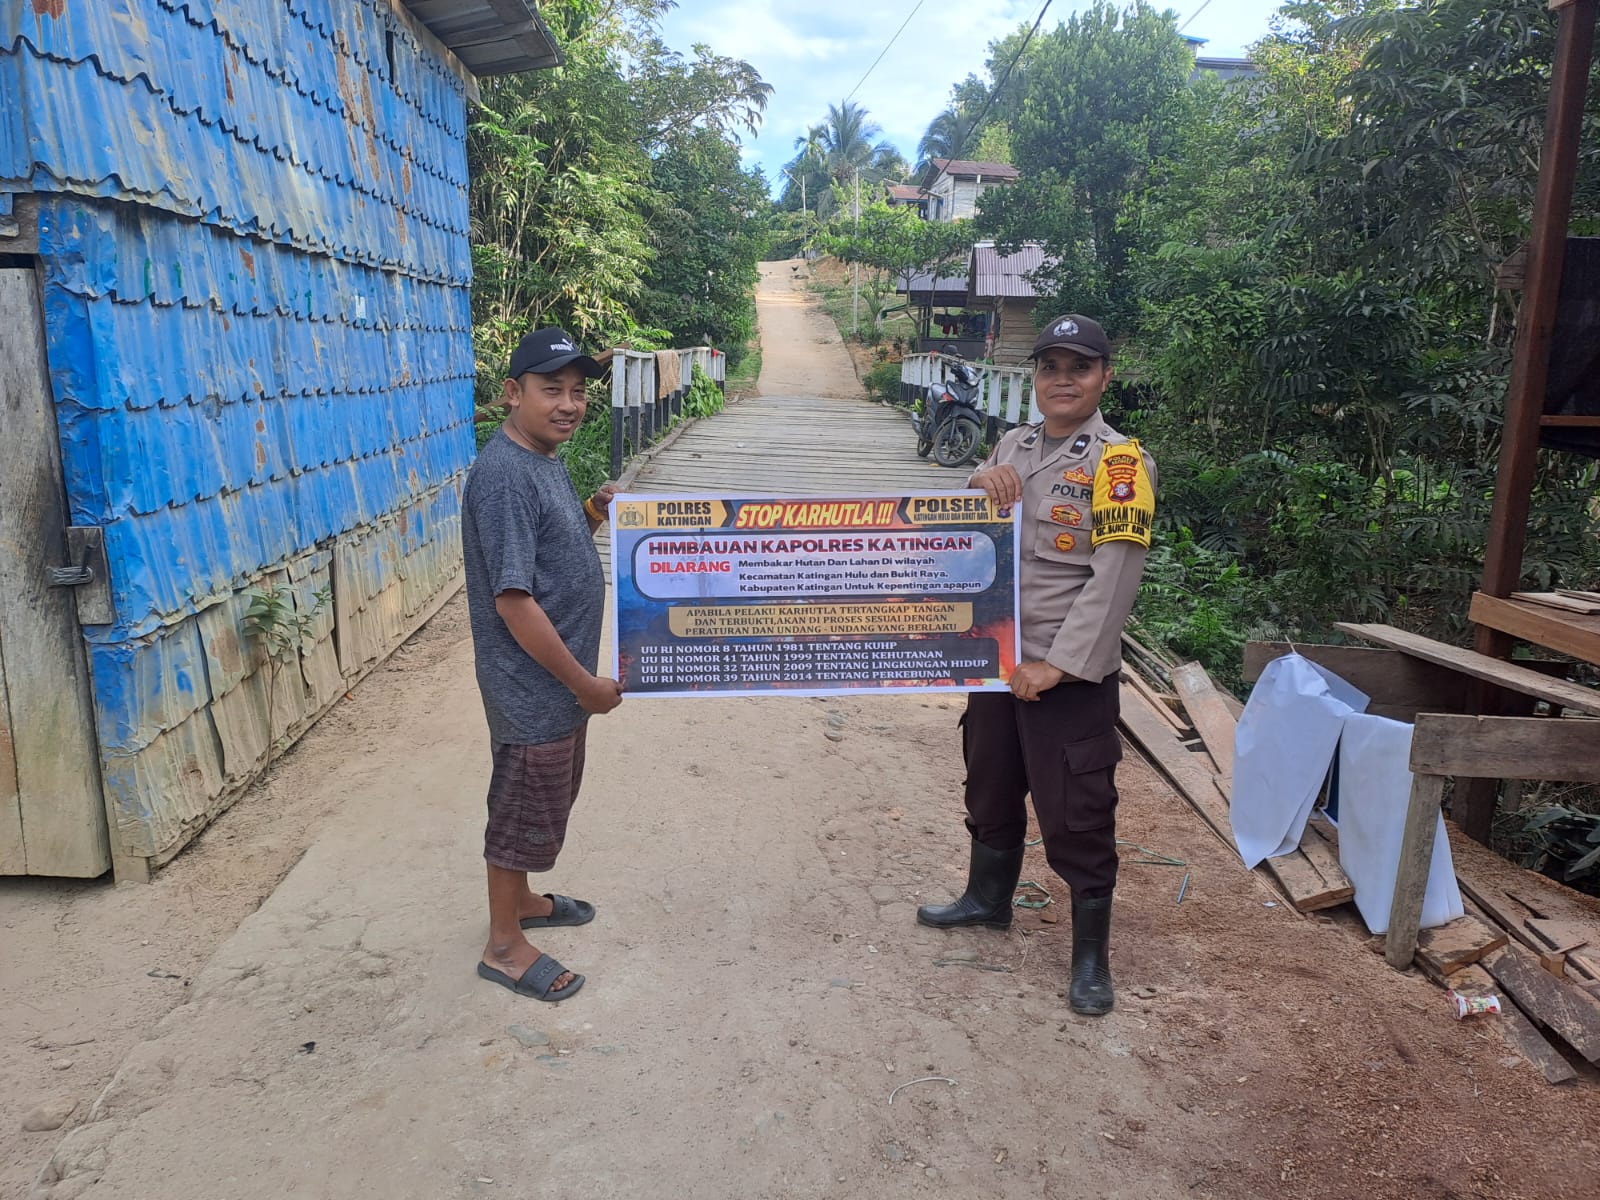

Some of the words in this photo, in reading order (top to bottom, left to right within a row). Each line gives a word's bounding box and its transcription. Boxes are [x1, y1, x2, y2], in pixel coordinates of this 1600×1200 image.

[657, 502, 711, 515] POLRES
[914, 498, 987, 512] POLSEK
[657, 516, 711, 526] KATINGAN
[735, 503, 784, 528] STOP
[782, 502, 874, 527] KARHUTLA
[875, 502, 896, 526] !!!
[648, 540, 757, 555] HIMBAUAN
[761, 539, 863, 553] KAPOLRES
[867, 537, 973, 552] KATINGAN
[650, 561, 731, 573] DILARANG
[738, 560, 792, 568] Membakar
[795, 559, 826, 567] Hutan
[827, 558, 848, 566] Dan
[849, 558, 880, 566] Lahan
[882, 557, 893, 565] Di
[894, 557, 935, 566] wilayah
[739, 573, 795, 581] Kecamatan
[797, 572, 842, 581] Katingan
[844, 571, 868, 579] Hulu
[870, 571, 889, 579] dan
[890, 570, 918, 578] Bukit
[920, 570, 949, 579] Raya.
[740, 584, 795, 593] Kabupaten
[797, 583, 842, 593] Katingan
[844, 582, 874, 591] Untuk
[877, 581, 942, 591] Kepentingan
[943, 582, 982, 590] apapun
[686, 609, 732, 617] APABILA
[734, 608, 776, 616] PELAKU
[778, 607, 837, 616] KARHUTLA
[839, 605, 909, 614] TERTANGKAP
[911, 605, 955, 613] TANGAN
[694, 618, 717, 626] DAN
[808, 616, 821, 624] DI
[823, 615, 863, 624] PROSES
[865, 615, 901, 623] SESUAI
[903, 614, 948, 622] DENGAN
[685, 626, 750, 636] PERATURAN
[752, 626, 775, 634] DAN
[777, 625, 821, 634] UNDANG
[830, 624, 875, 633] UNDANG
[877, 624, 905, 632] YANG
[907, 623, 957, 632] BERLAKU
[641, 646, 658, 654] UU
[660, 646, 673, 654] RI
[675, 645, 721, 654] NOMOR
[722, 645, 731, 653] 8
[733, 644, 774, 653] TAHUN
[776, 643, 805, 652] 1981
[807, 642, 862, 651] TENTANG
[864, 641, 898, 650] KUHP
[641, 656, 658, 664] UU
[660, 656, 673, 664] RI
[676, 655, 721, 663] NOMOR
[740, 653, 781, 662] TAHUN
[783, 653, 813, 661] 1999
[814, 652, 870, 660] TENTANG
[871, 651, 944, 660] KEHUTANAN
[641, 665, 658, 674] UU
[660, 665, 673, 673] RI
[676, 665, 721, 673] NOMOR
[723, 664, 738, 672] 32
[740, 663, 781, 672] TAHUN
[783, 662, 813, 671] 2009
[815, 661, 870, 670] TENTANG
[872, 660, 949, 669] LINGKUNGAN
[950, 659, 990, 668] HIDUP
[641, 675, 658, 684] UU
[660, 675, 673, 683] RI
[676, 674, 721, 683] NOMOR
[723, 674, 738, 682] 39
[740, 673, 781, 682] TAHUN
[783, 672, 813, 681] 2014
[815, 671, 870, 680] TENTANG
[872, 669, 952, 679] PERKEBUNAN
